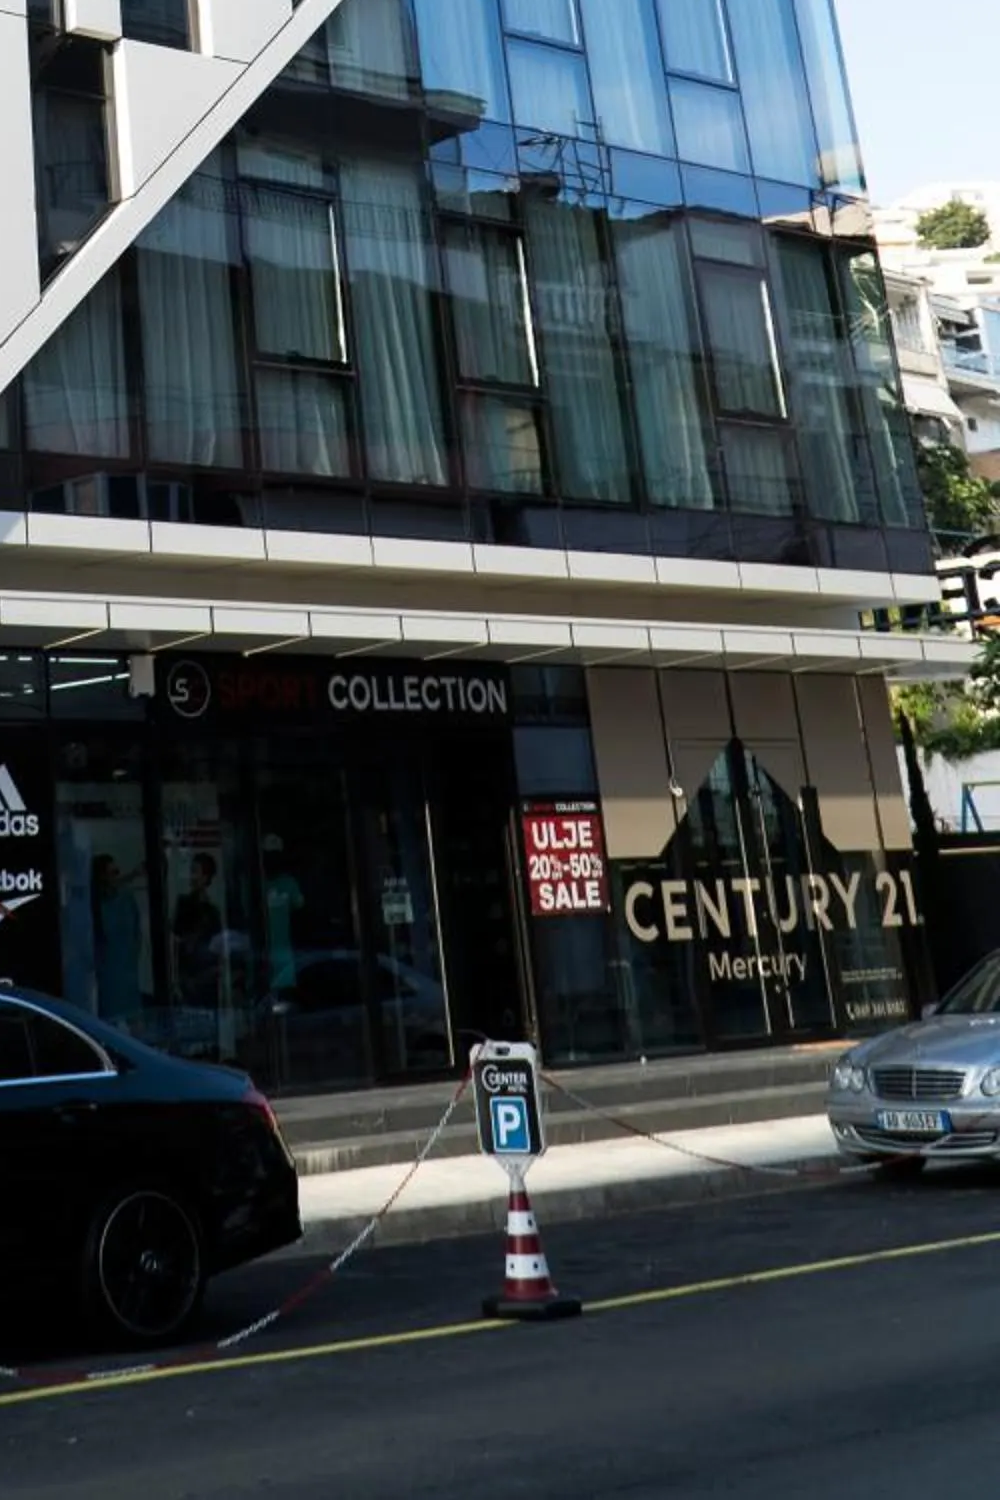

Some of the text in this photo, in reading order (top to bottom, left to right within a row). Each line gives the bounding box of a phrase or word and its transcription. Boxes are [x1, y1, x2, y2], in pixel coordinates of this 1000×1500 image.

[328, 675, 508, 713] COLLECTION
[531, 820, 593, 849] ULJE
[539, 881, 601, 910] SALE
[625, 870, 860, 942] CENTURY
[709, 950, 806, 981] Mercury
[497, 1104, 521, 1146] P
